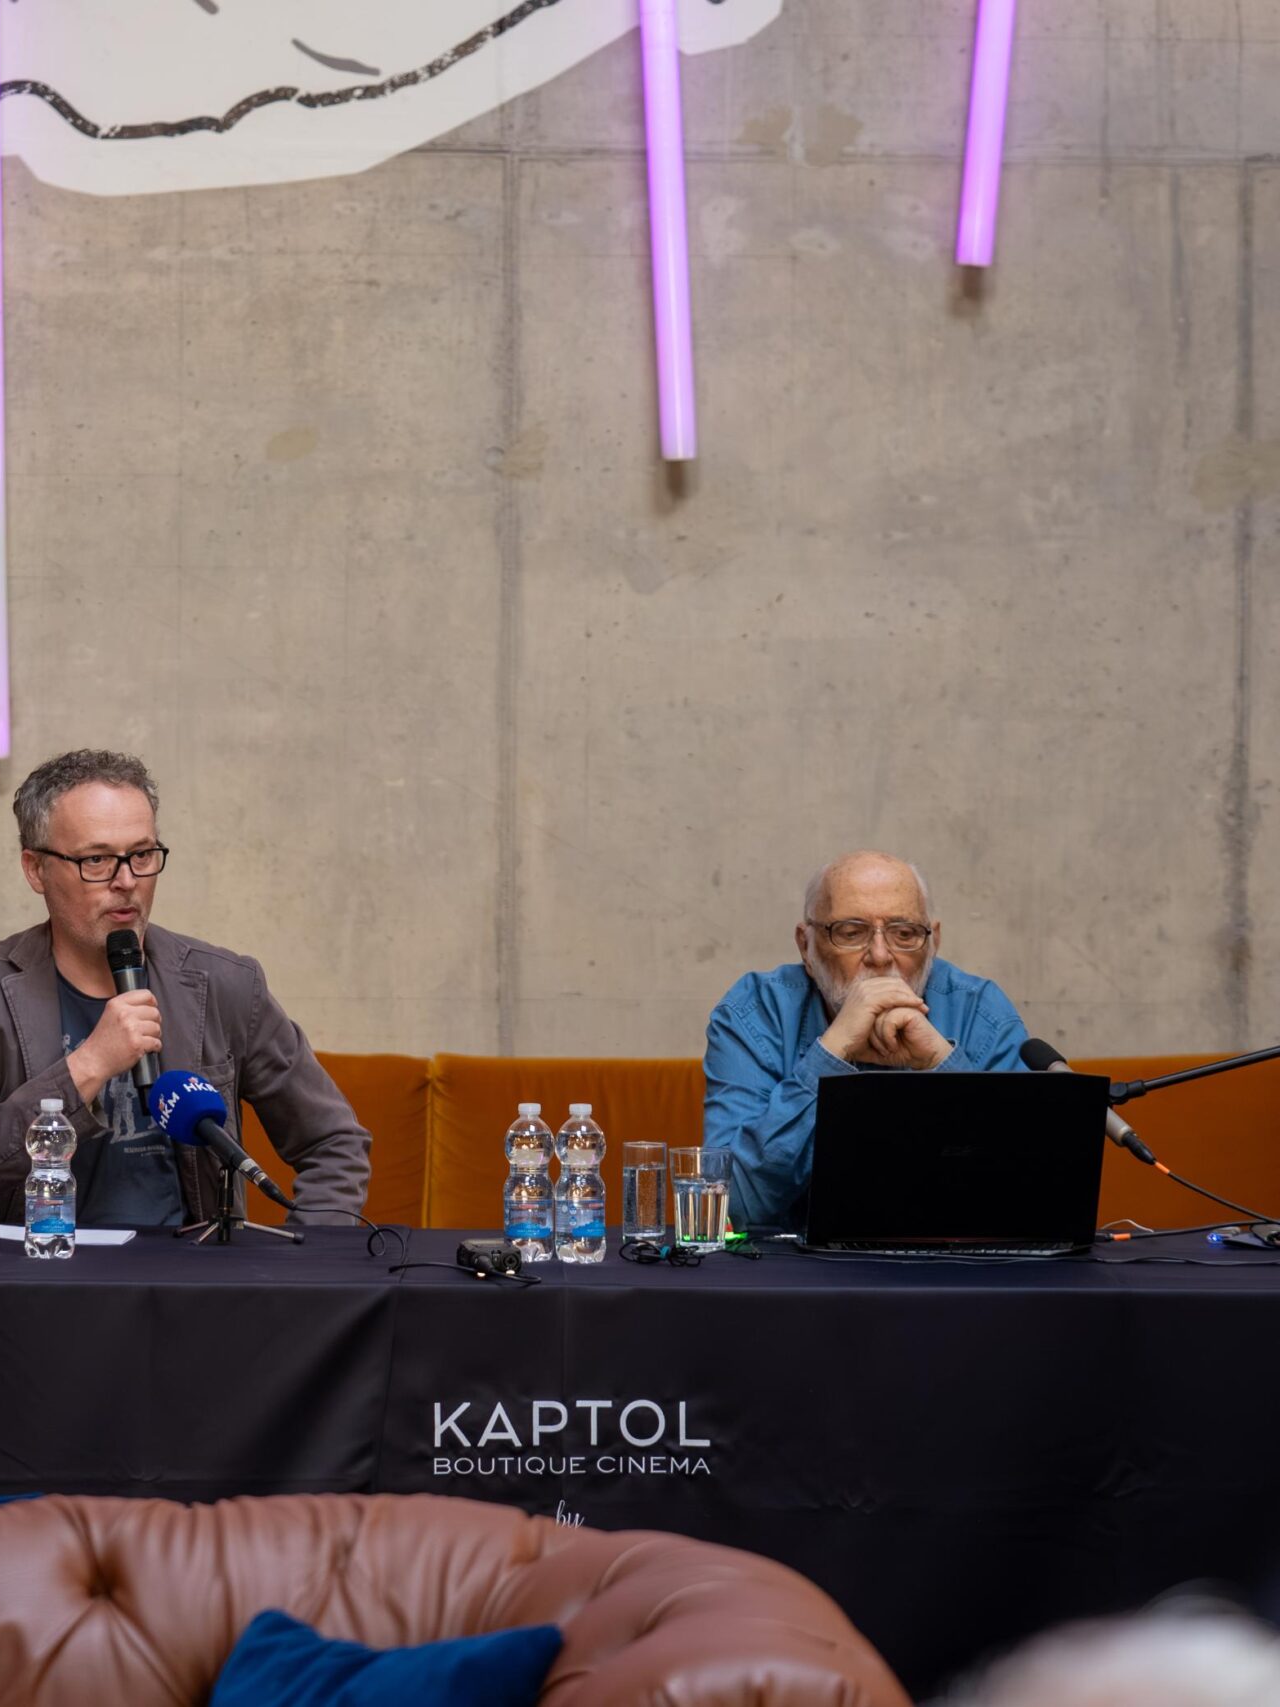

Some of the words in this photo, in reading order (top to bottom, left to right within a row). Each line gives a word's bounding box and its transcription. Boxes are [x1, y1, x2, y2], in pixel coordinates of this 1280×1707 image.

[158, 1091, 180, 1129] HKM
[433, 1399, 711, 1447] KAPTOL
[433, 1456, 586, 1475] BOUTIQUE
[596, 1456, 711, 1475] CINEMA
